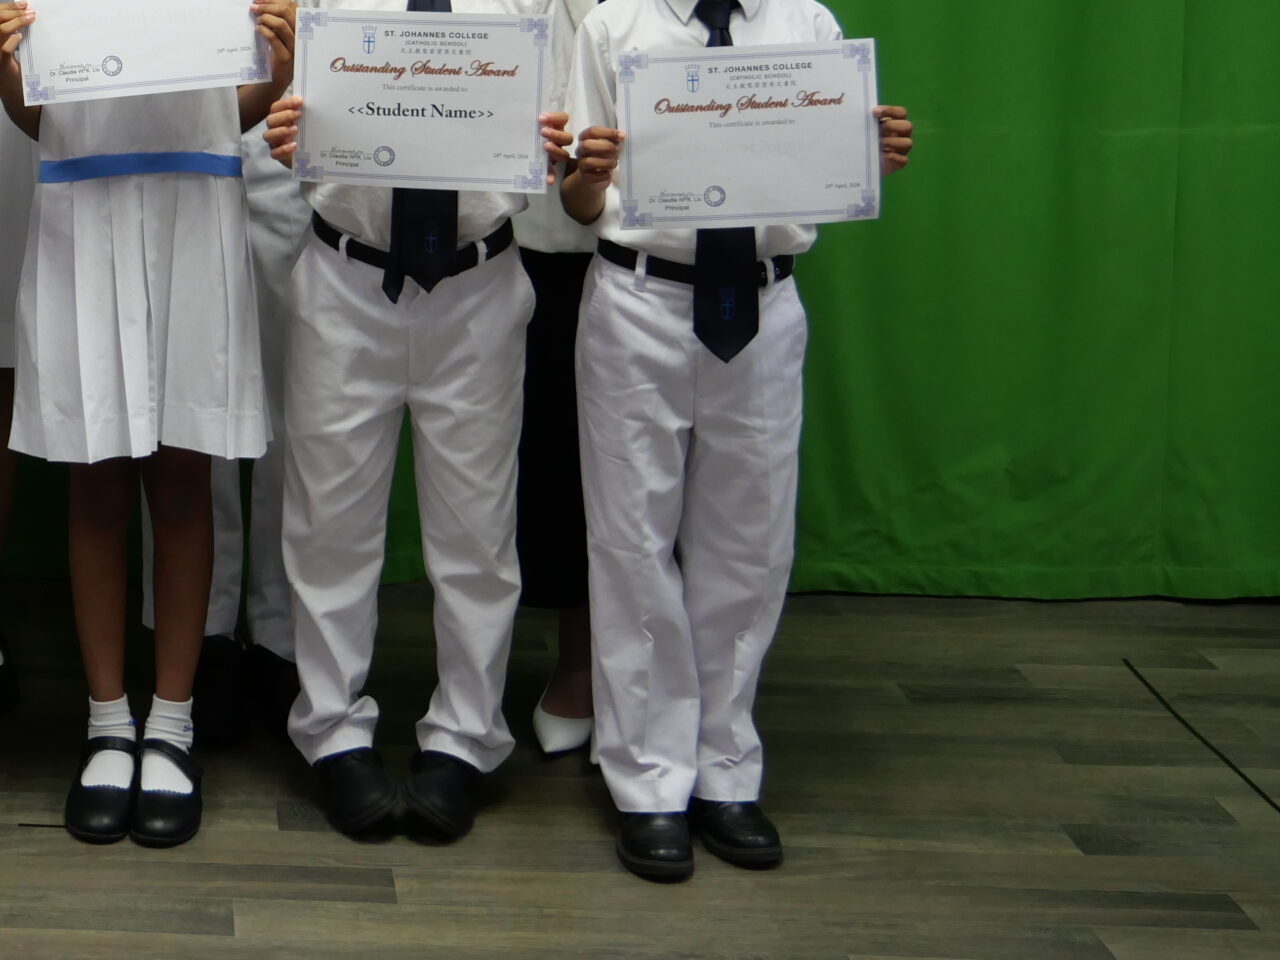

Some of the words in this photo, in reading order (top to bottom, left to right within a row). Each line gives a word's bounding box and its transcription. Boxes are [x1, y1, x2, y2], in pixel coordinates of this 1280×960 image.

[330, 57, 407, 80] Outstanding
[410, 60, 462, 77] Student
[464, 60, 518, 77] Award
[723, 65, 769, 73] JOHANNES
[773, 62, 812, 70] COLLEGE
[349, 102, 426, 117] <<Student
[431, 104, 493, 118] Name>>
[654, 98, 733, 118] Outstanding
[736, 94, 788, 113] Student
[791, 90, 845, 107] Award
